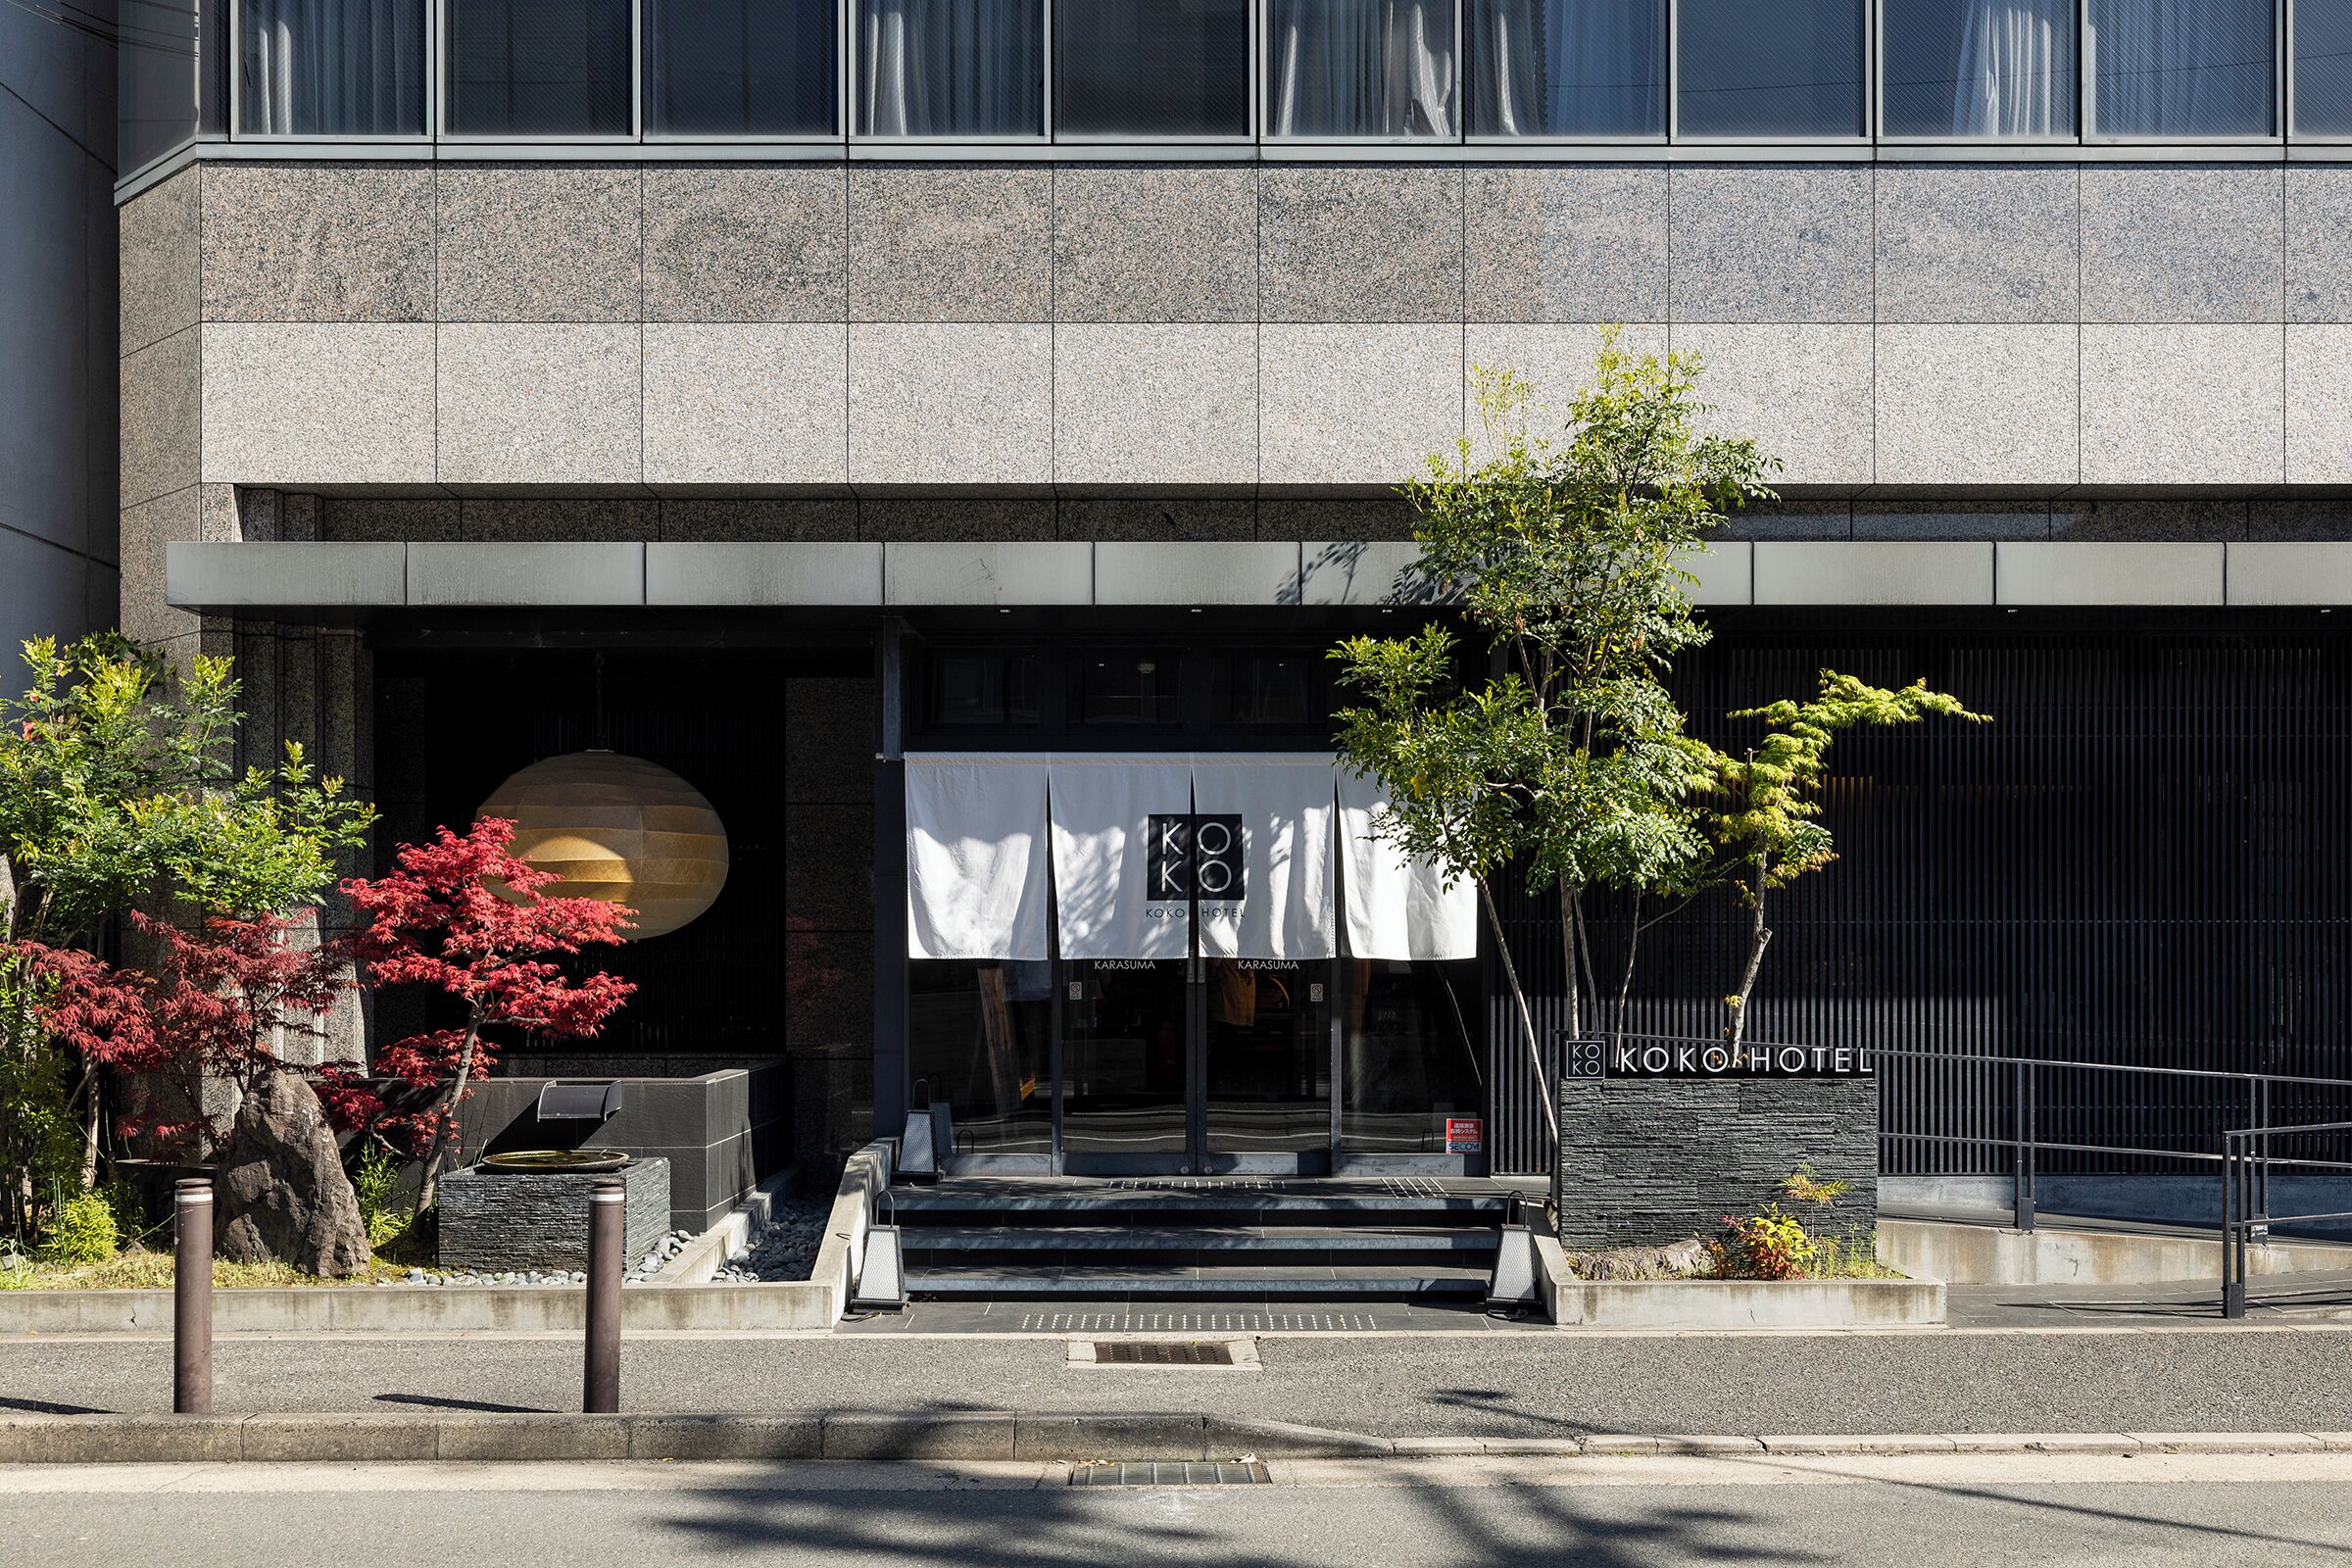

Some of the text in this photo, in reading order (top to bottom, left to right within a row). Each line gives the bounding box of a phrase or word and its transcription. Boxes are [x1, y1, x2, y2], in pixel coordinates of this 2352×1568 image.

[1161, 822, 1231, 856] KO
[1161, 859, 1232, 893] KO
[1146, 907, 1246, 918] KOKO HOTEL
[1094, 960, 1155, 970] KARASUMA
[1238, 960, 1299, 970] KARASUMA
[1572, 1044, 1600, 1059] KO
[1572, 1059, 1600, 1075] KO
[1620, 1047, 1873, 1073] KOKO HOTEL
